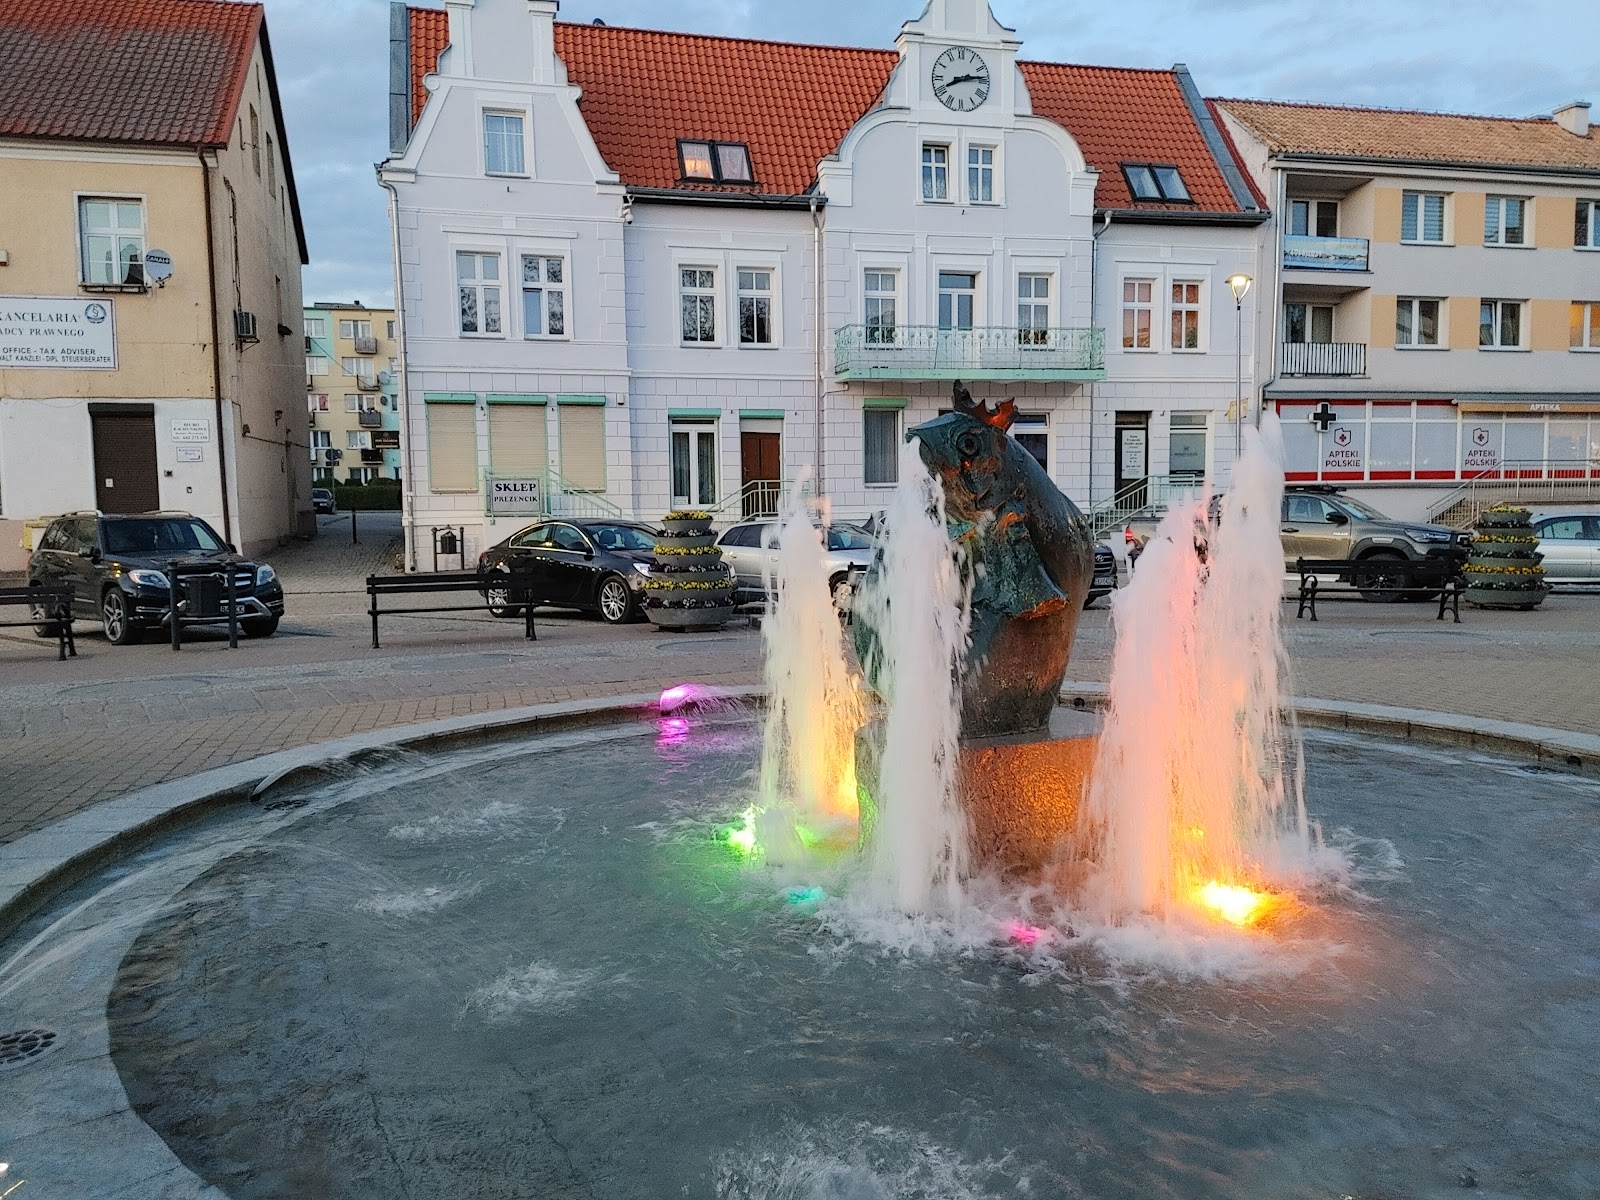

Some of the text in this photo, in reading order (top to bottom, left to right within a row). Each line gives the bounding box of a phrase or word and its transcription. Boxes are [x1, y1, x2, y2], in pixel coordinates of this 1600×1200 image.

[29, 328, 84, 337] PRAWNEGO
[2, 347, 31, 355] OFFICE
[40, 347, 56, 355] TAX
[1530, 403, 1560, 411] APTEKA
[1328, 450, 1359, 458] APTEKI
[1467, 450, 1496, 458] APTEKI
[1325, 460, 1361, 468] POLSKIE
[494, 483, 537, 492] SKLEP
